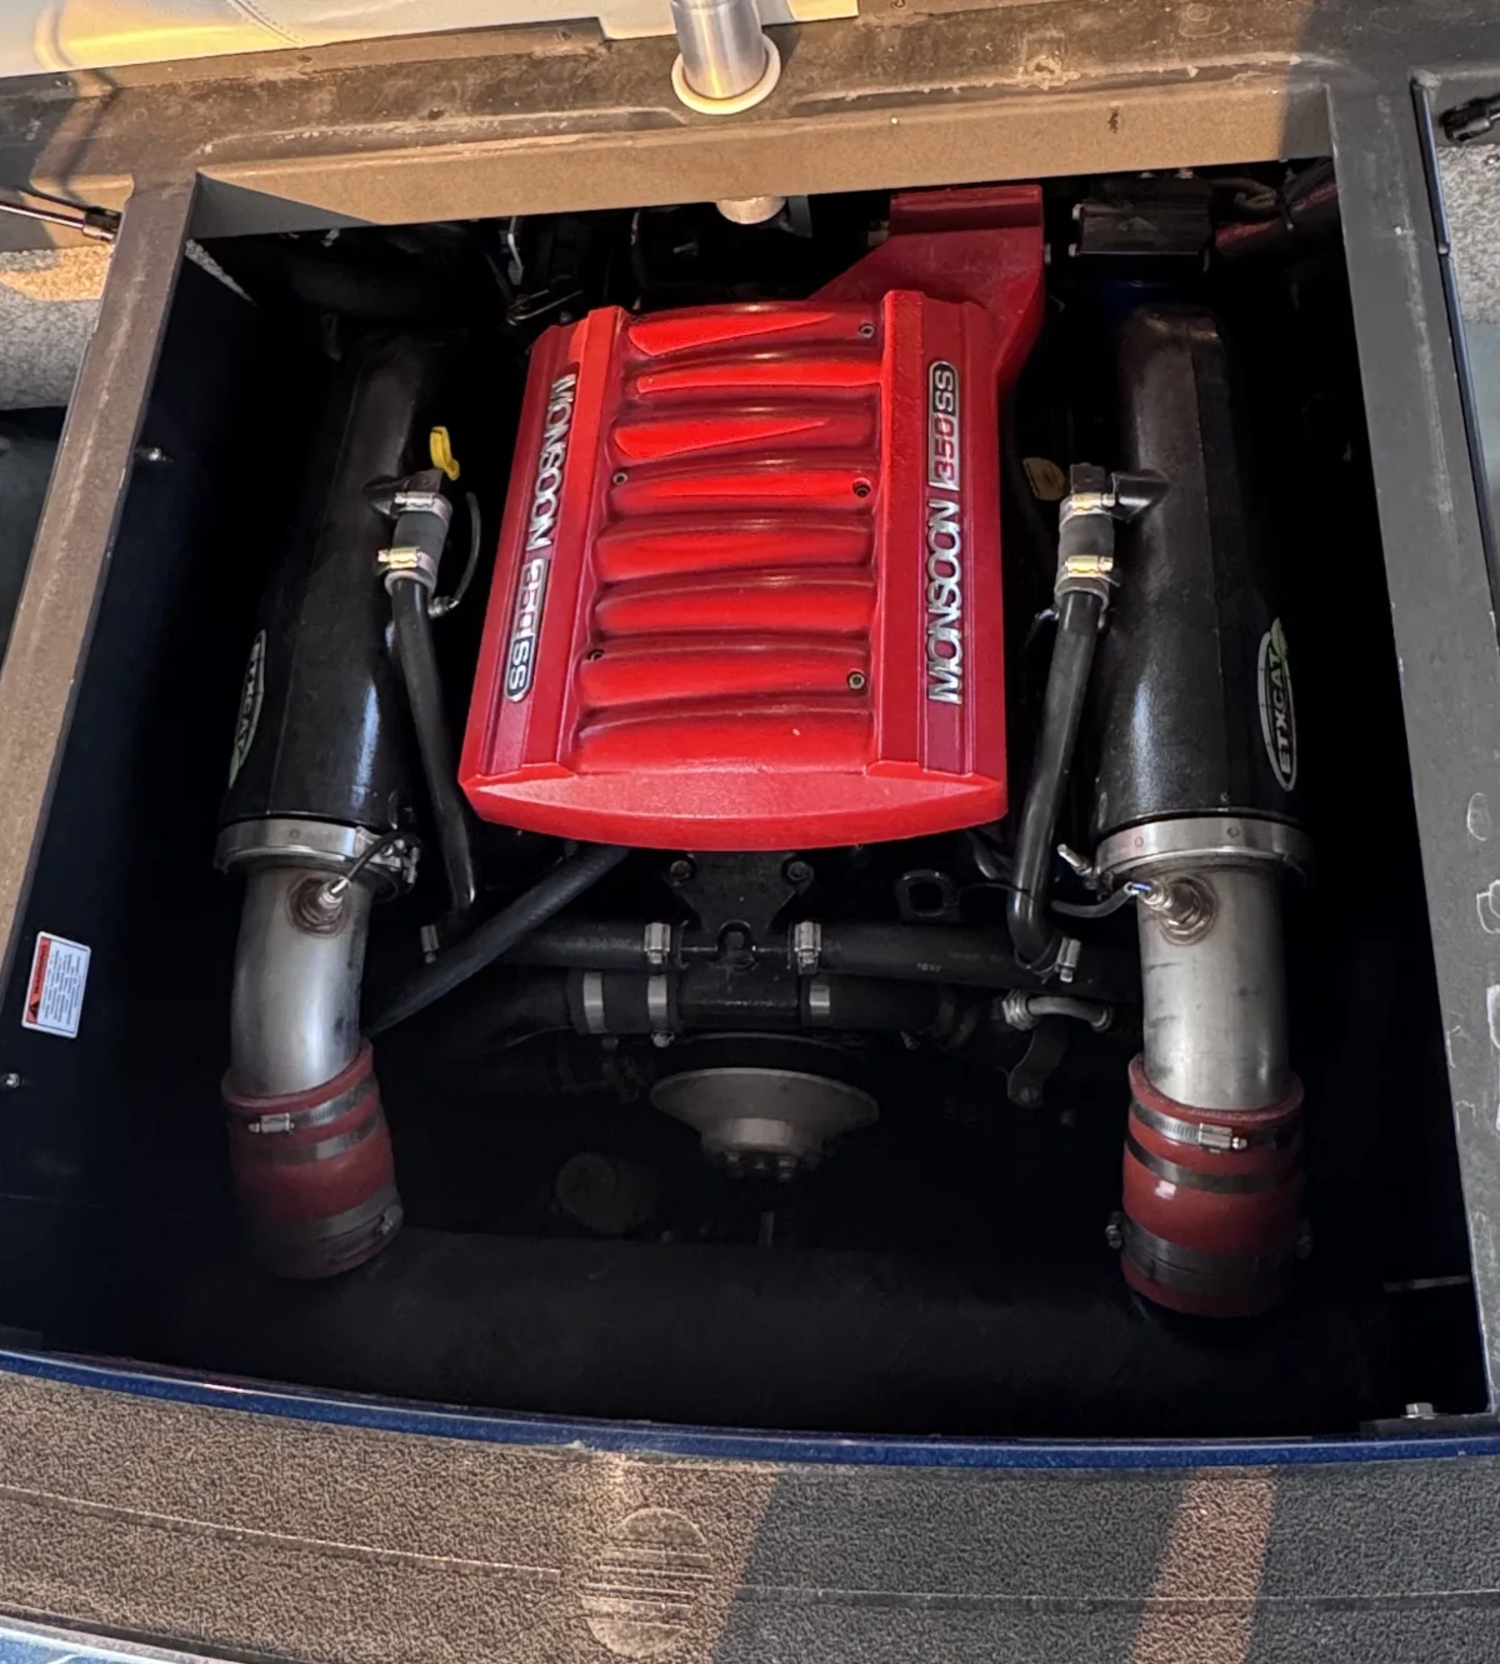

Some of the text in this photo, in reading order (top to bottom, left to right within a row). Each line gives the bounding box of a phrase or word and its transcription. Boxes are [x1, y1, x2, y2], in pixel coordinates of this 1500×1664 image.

[527, 374, 576, 551] MONSOON
[926, 501, 962, 705] MONSOON
[1269, 646, 1291, 774] ETXCAT
